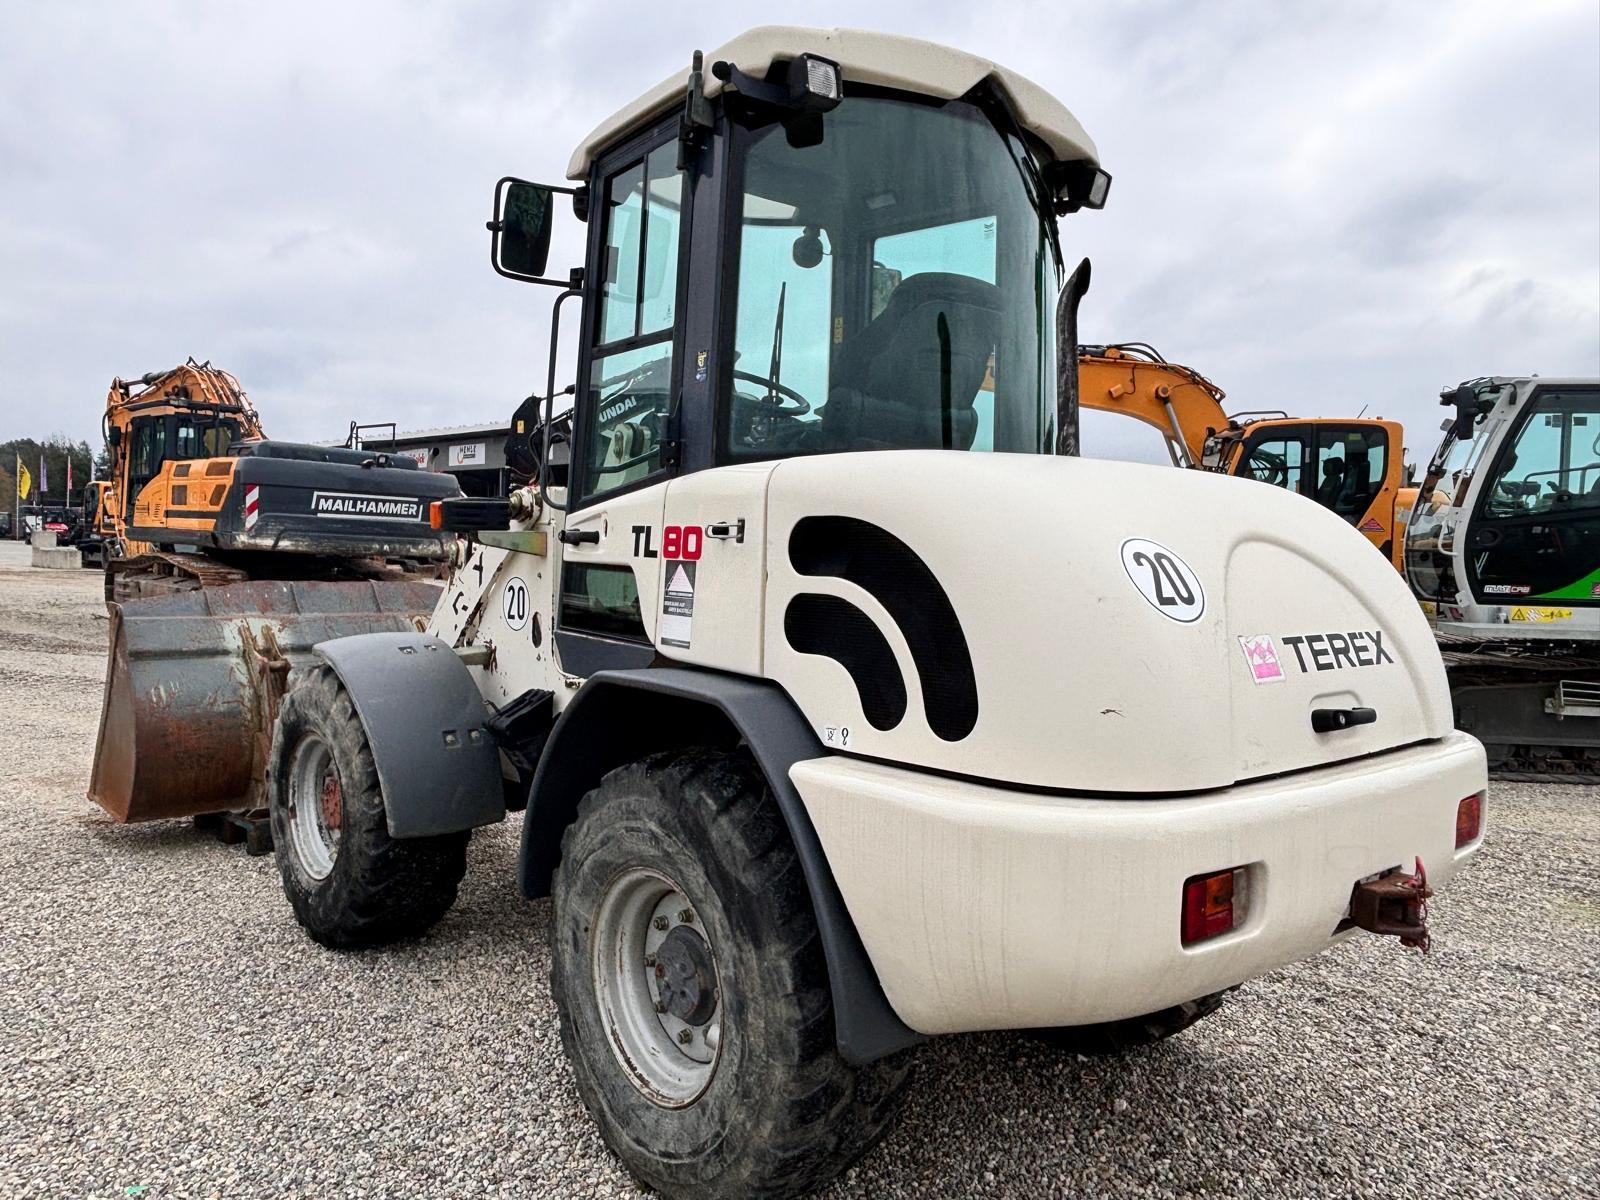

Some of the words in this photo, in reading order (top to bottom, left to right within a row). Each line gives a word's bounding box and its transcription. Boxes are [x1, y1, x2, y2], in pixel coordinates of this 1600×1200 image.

[318, 498, 418, 516] MAILHAMMER
[1132, 551, 1195, 606] 20
[507, 585, 525, 620] 20
[1282, 631, 1394, 673] TEREX
